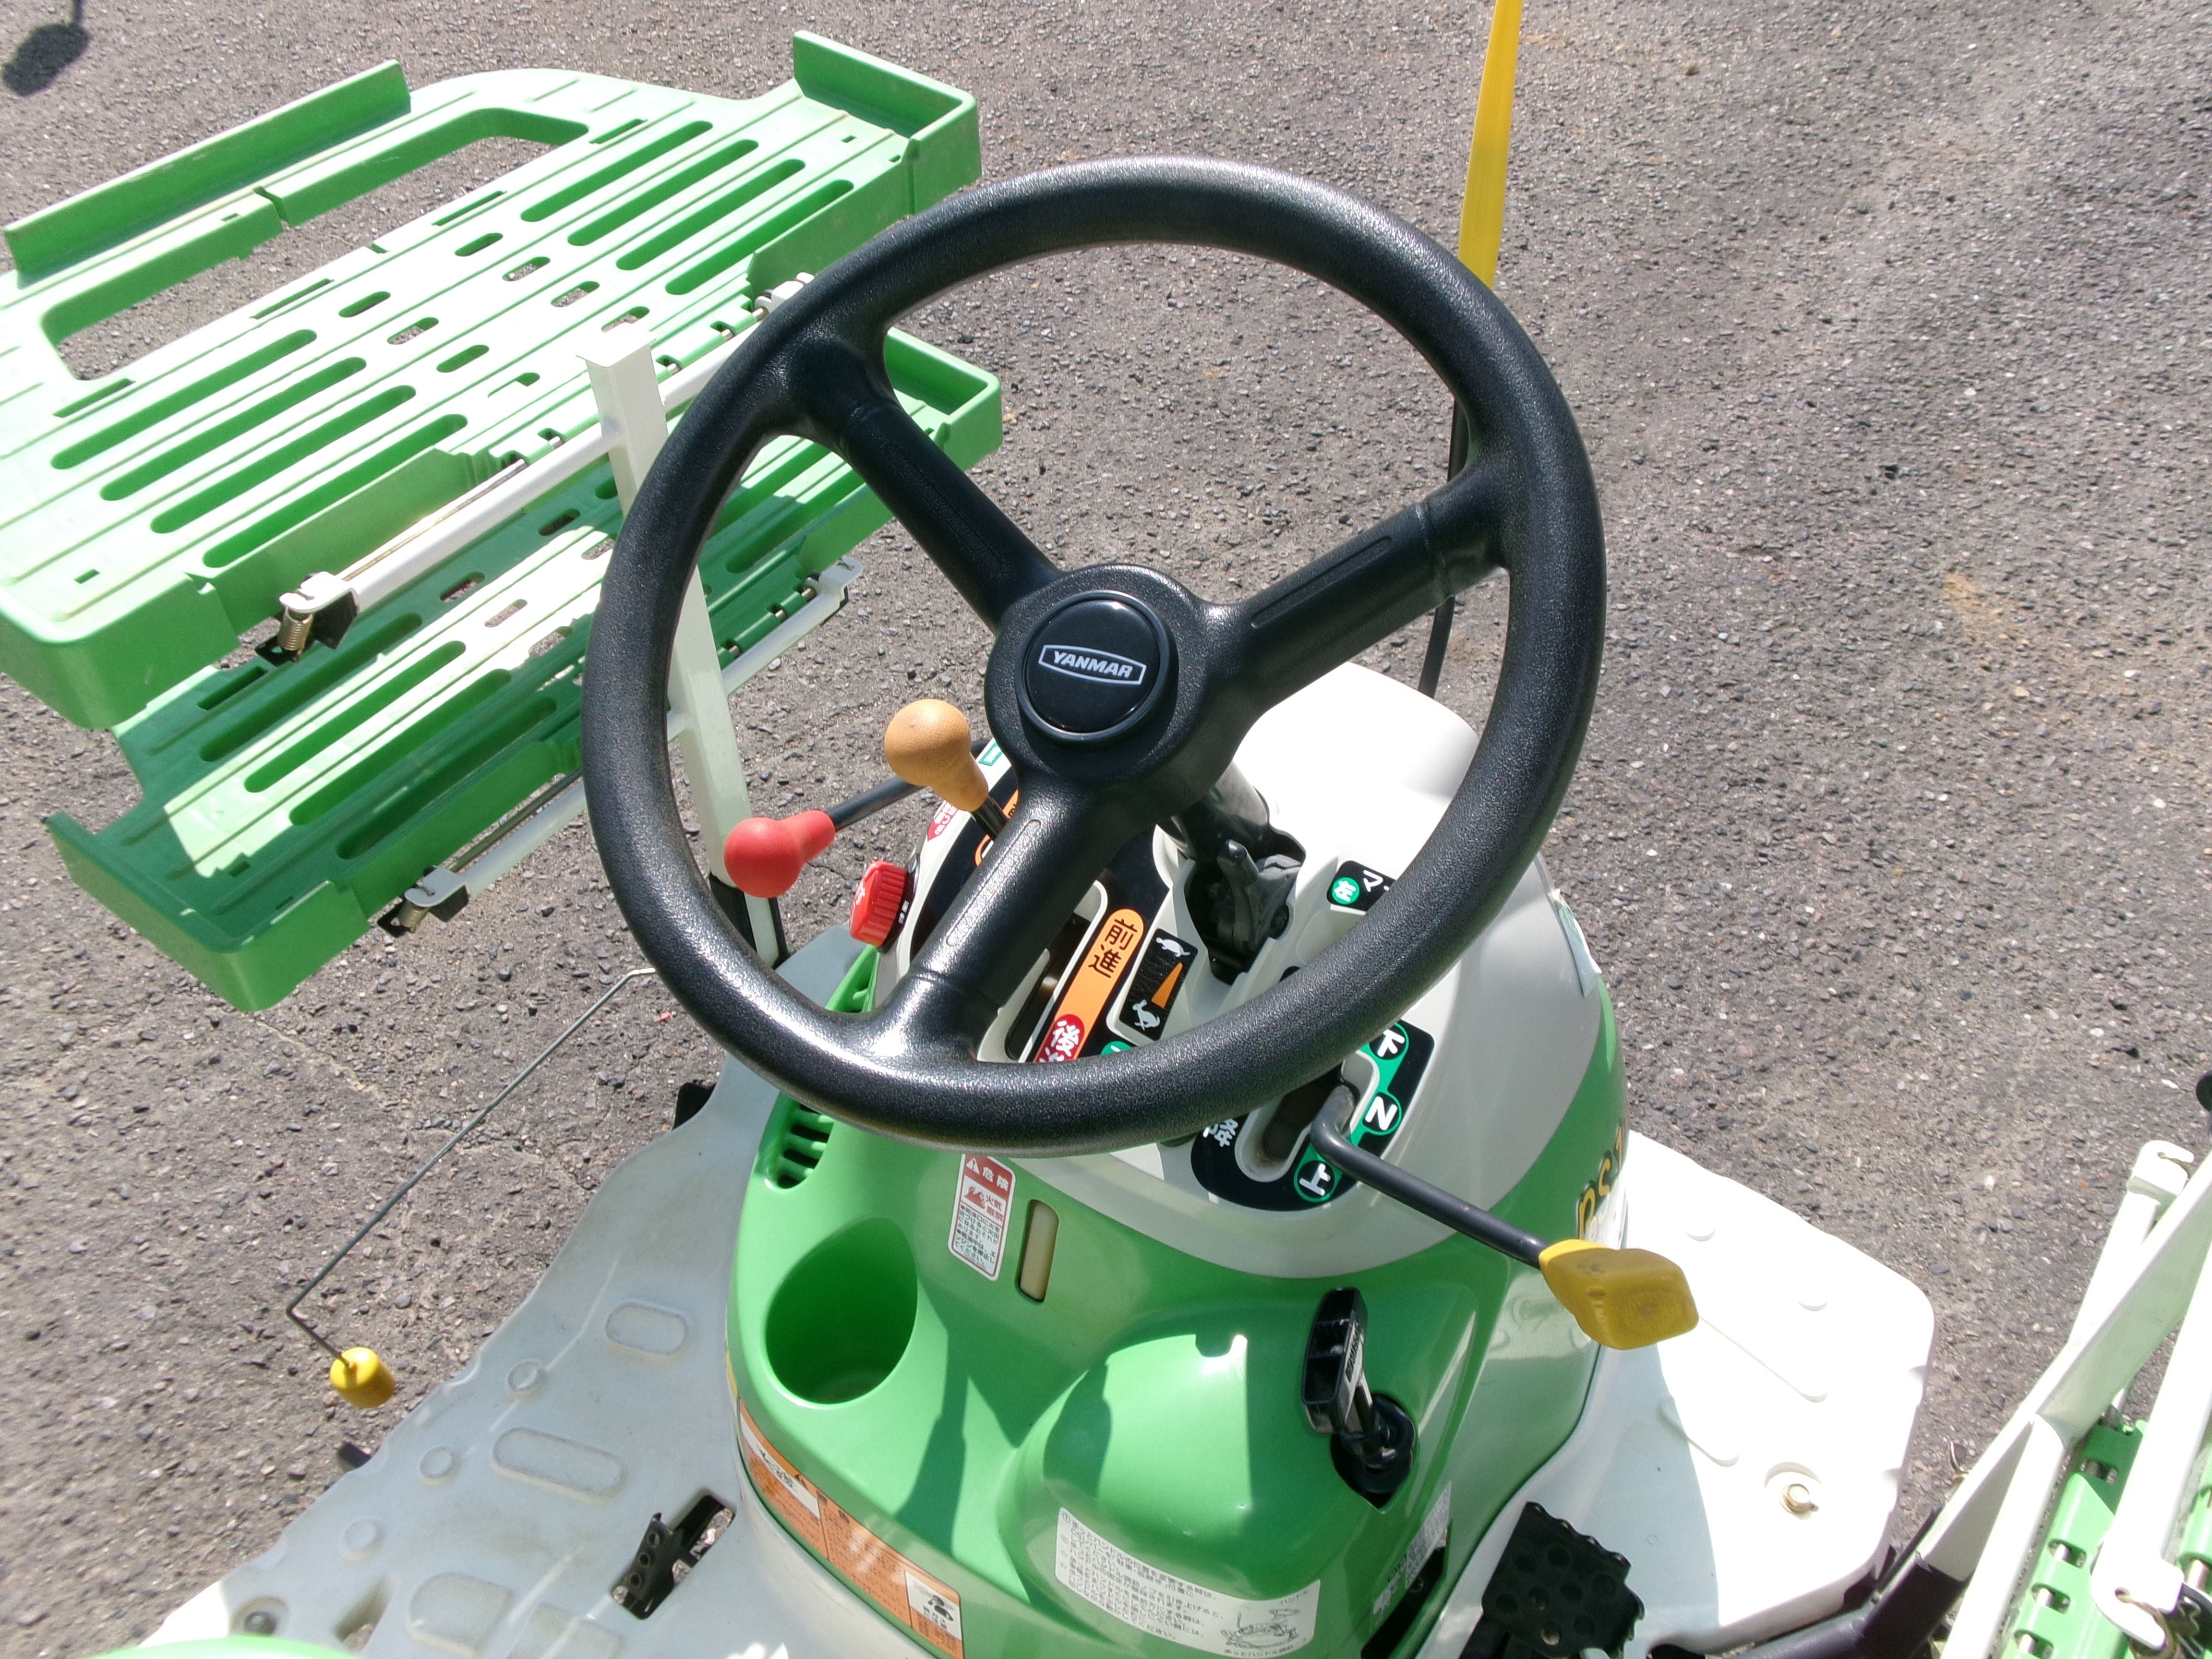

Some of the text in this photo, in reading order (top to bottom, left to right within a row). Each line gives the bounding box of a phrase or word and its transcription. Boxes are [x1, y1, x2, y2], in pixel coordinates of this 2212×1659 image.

[1054, 650, 1133, 678] YANMAR
[1332, 878, 1357, 903] 左
[1363, 869, 1390, 891] マ
[1088, 918, 1138, 979] 前進
[1377, 1029, 1405, 1058] 下
[1365, 1096, 1398, 1131] N
[982, 1165, 1010, 1192] 危険
[1298, 1162, 1332, 1197] 上
[985, 1193, 1003, 1211] 火気
